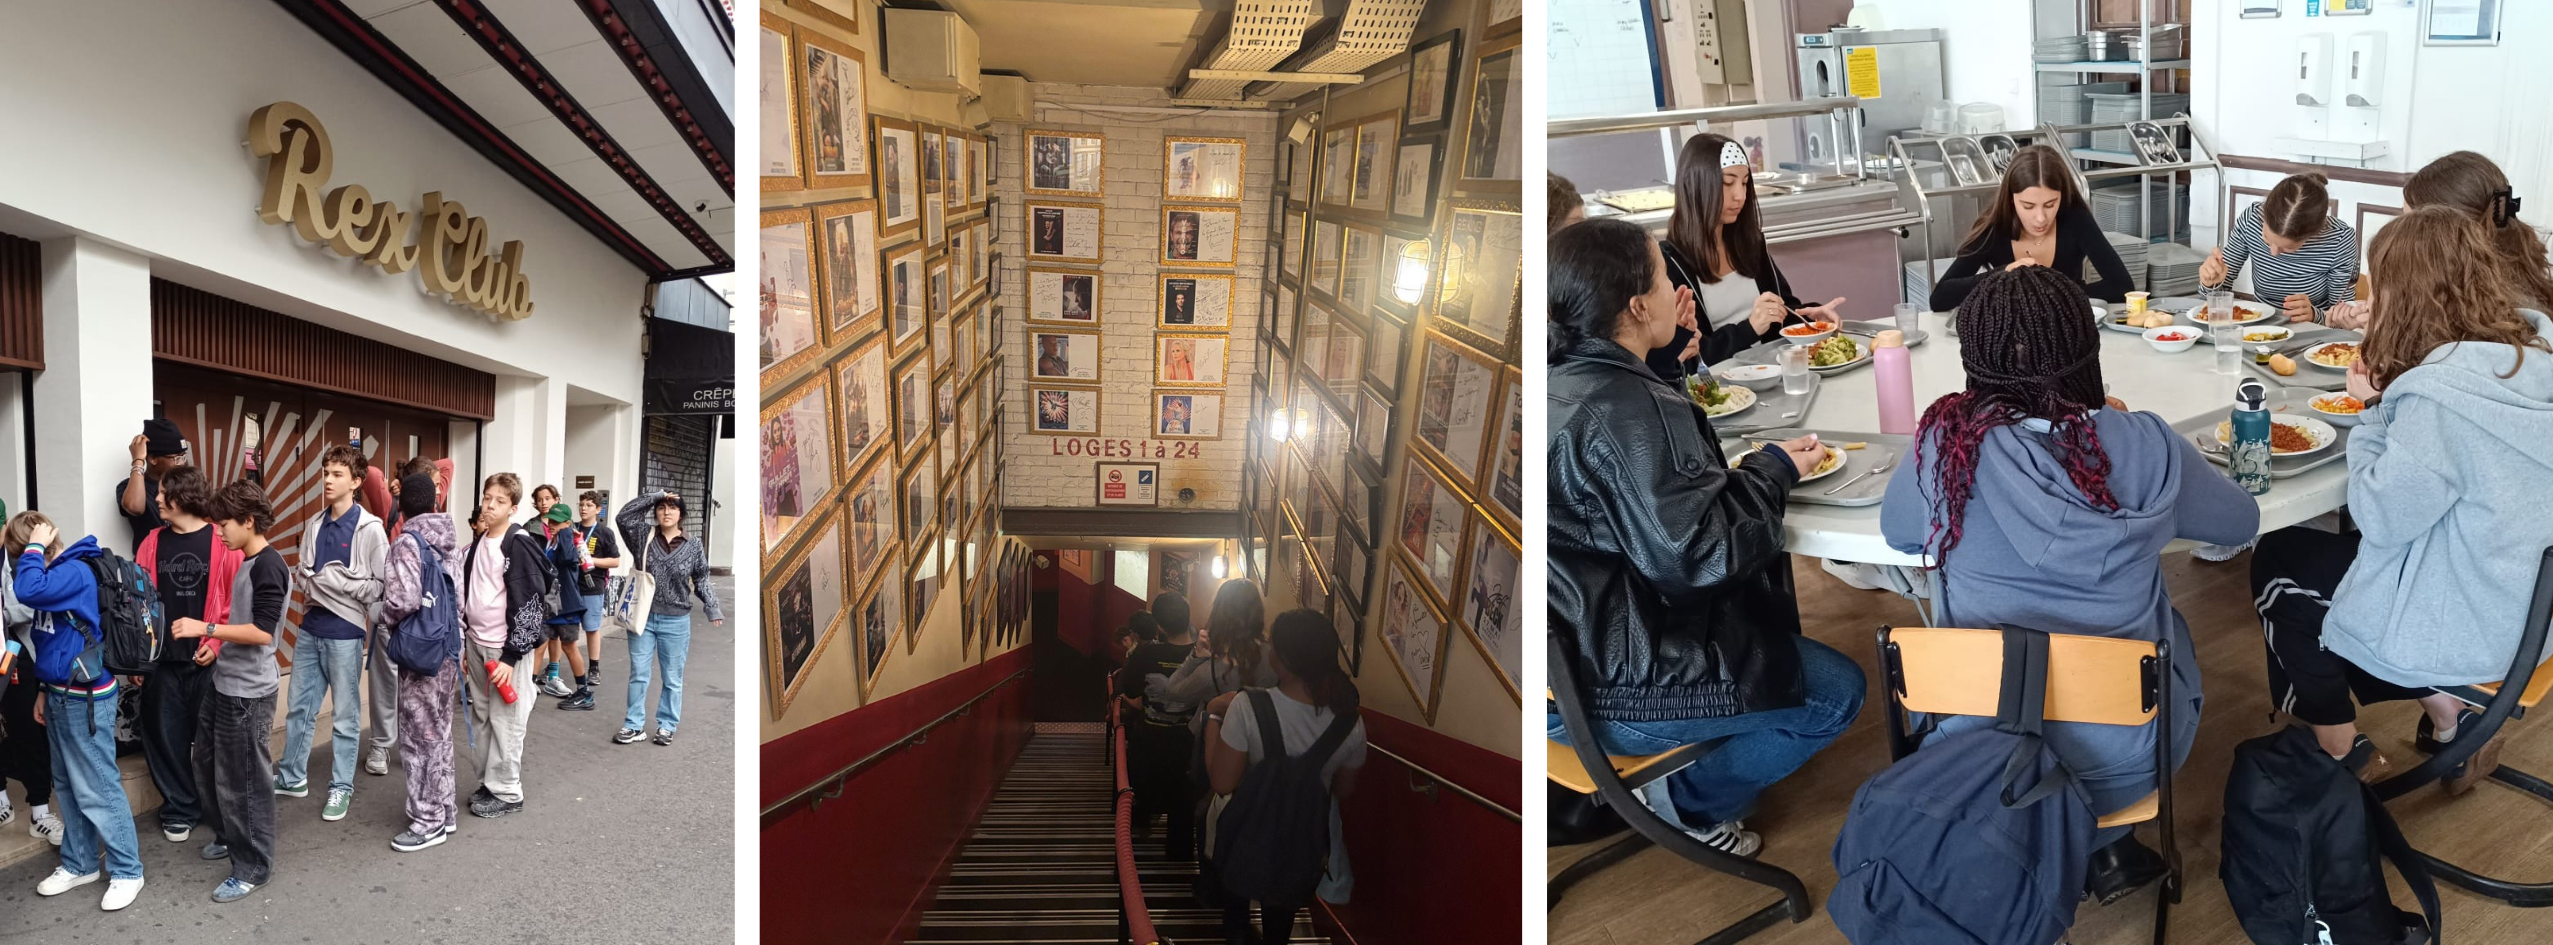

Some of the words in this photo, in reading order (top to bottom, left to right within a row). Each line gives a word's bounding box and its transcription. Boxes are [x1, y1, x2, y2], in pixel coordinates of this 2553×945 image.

[249, 101, 420, 275] Rex
[418, 190, 535, 321] Club
[683, 401, 719, 409] PANINIS
[1052, 438, 1132, 457] LOGES
[1139, 440, 1147, 457] 1
[1155, 440, 1166, 458] à
[1173, 441, 1200, 459] 24
